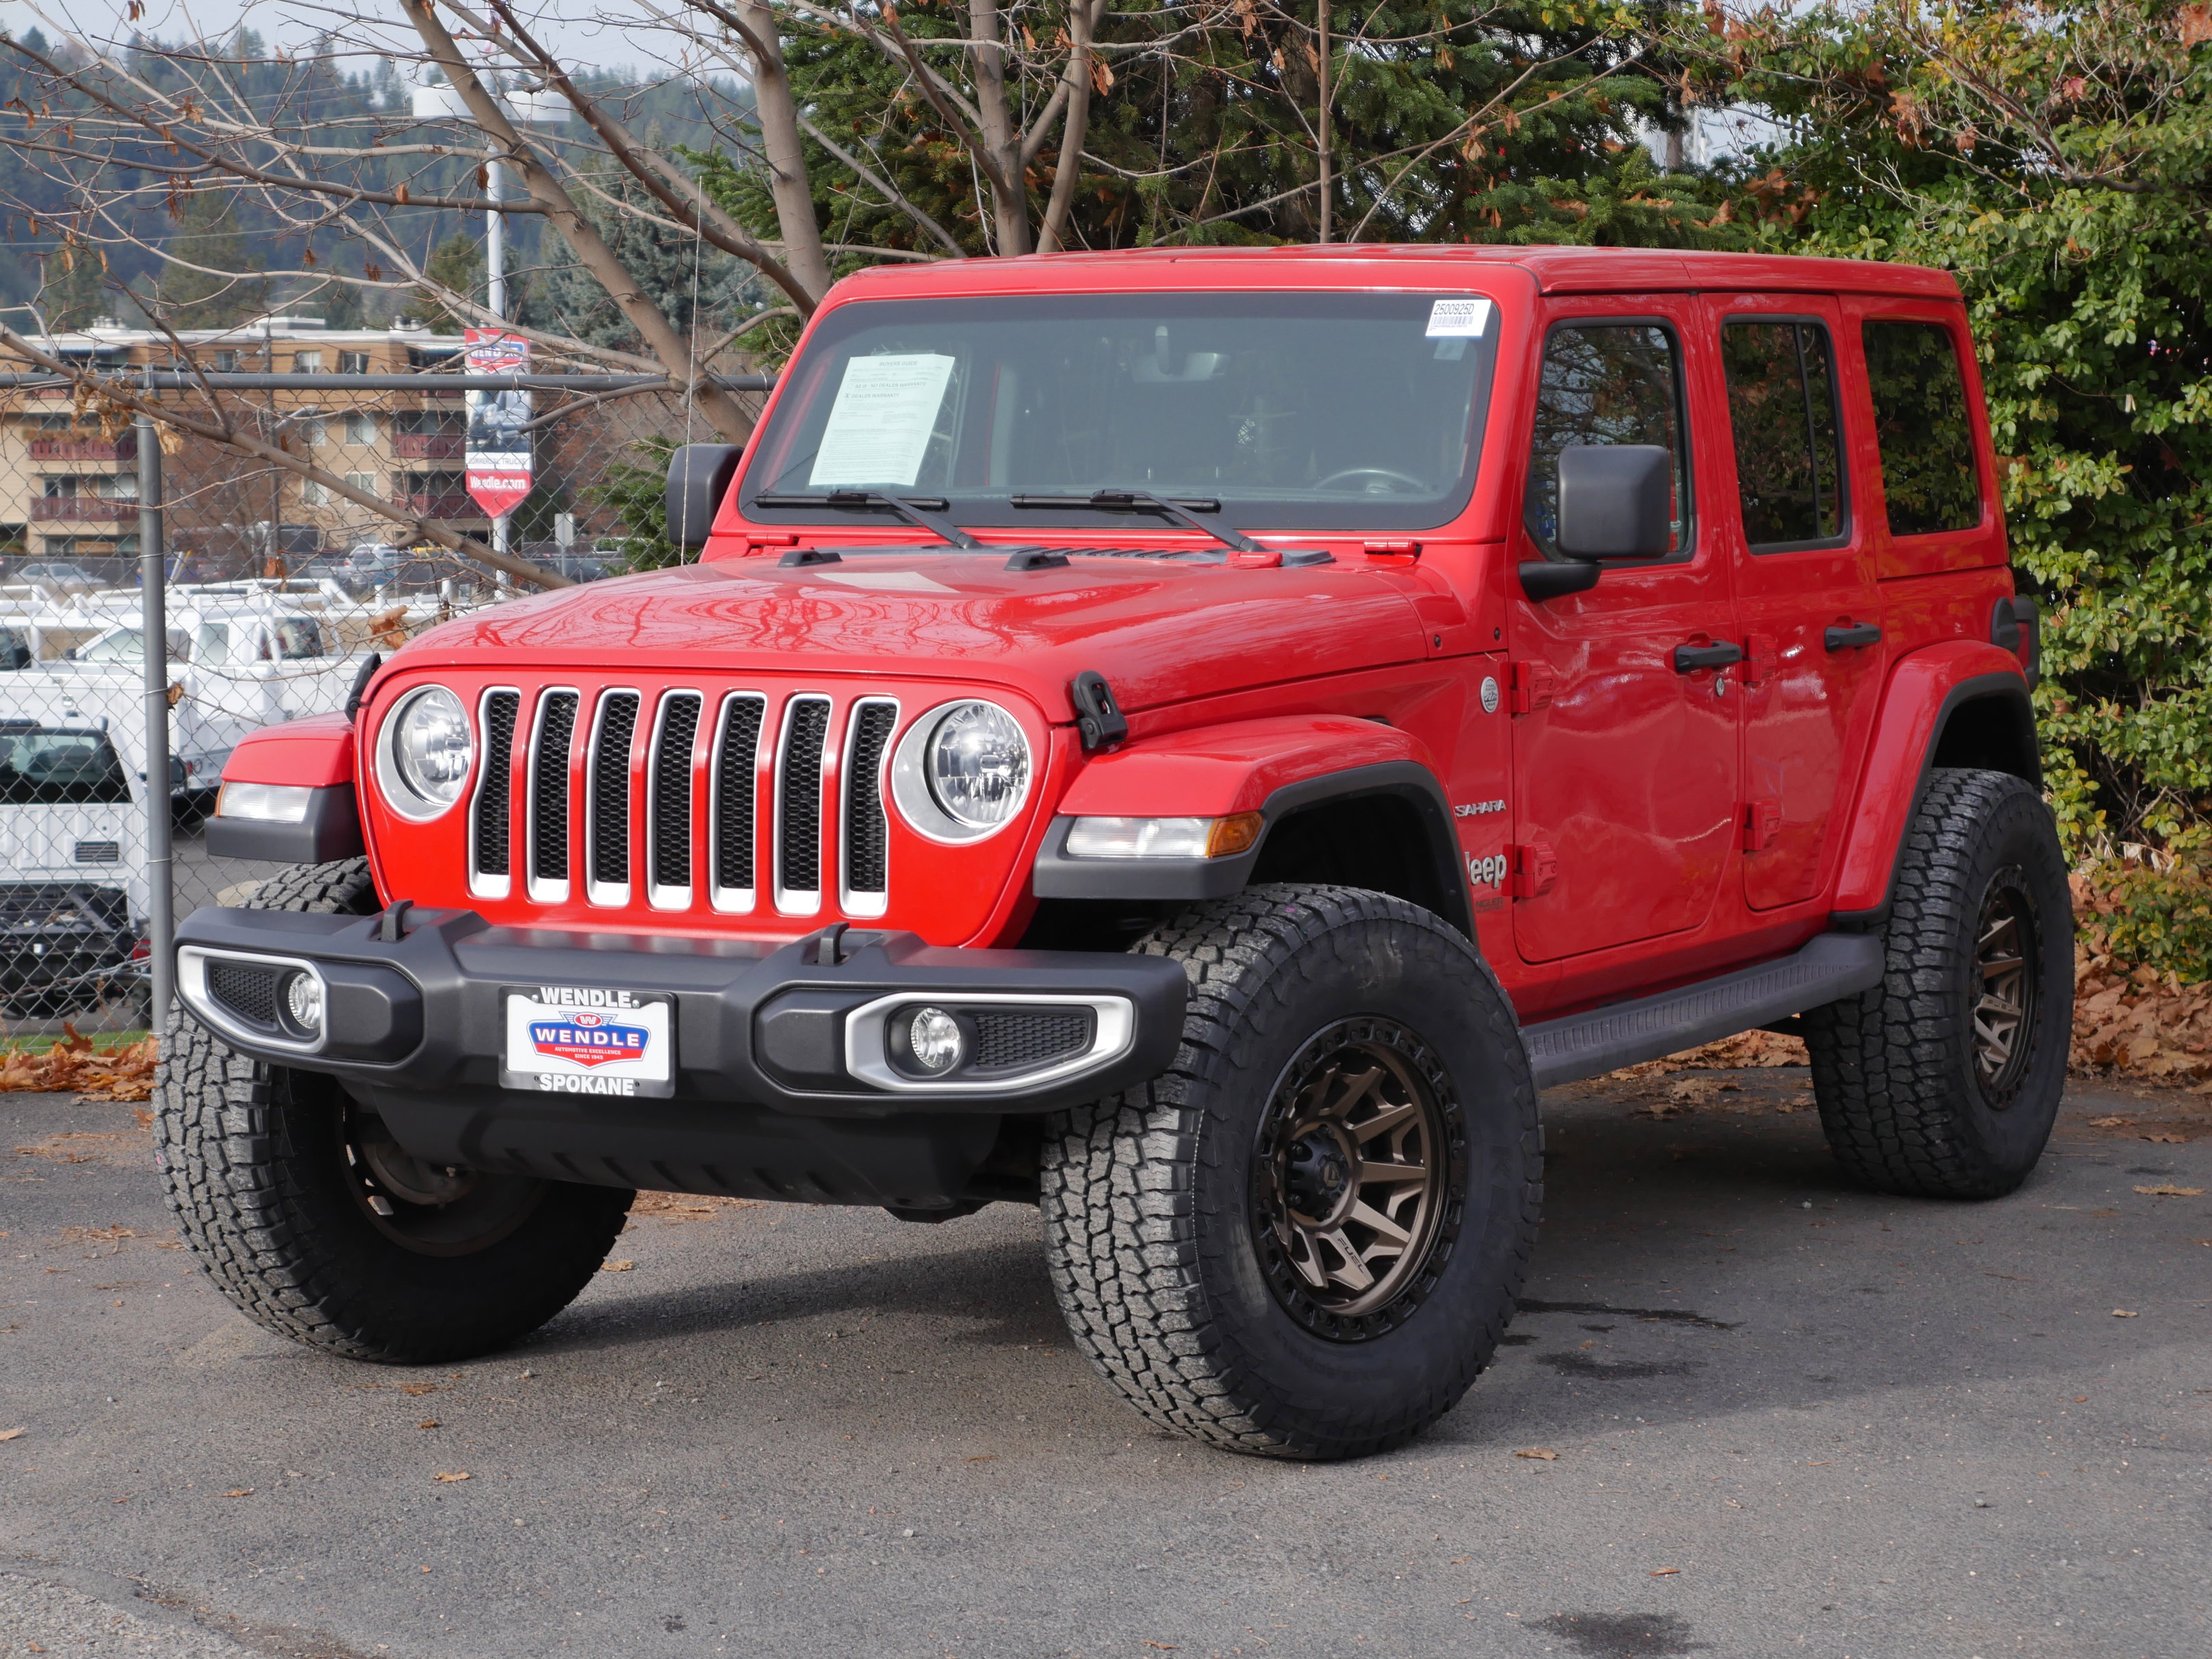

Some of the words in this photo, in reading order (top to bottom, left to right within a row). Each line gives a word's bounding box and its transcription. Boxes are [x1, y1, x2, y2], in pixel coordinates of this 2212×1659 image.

[1433, 303, 1475, 316] 2500925D
[470, 476, 526, 489] Wendle.com
[1455, 799, 1506, 817] SAHARA
[539, 987, 632, 1008] WENDLE
[535, 1028, 640, 1047] WENDLE
[539, 1074, 634, 1096] SPOKANE
[1337, 1237, 1365, 1274] FUEL
